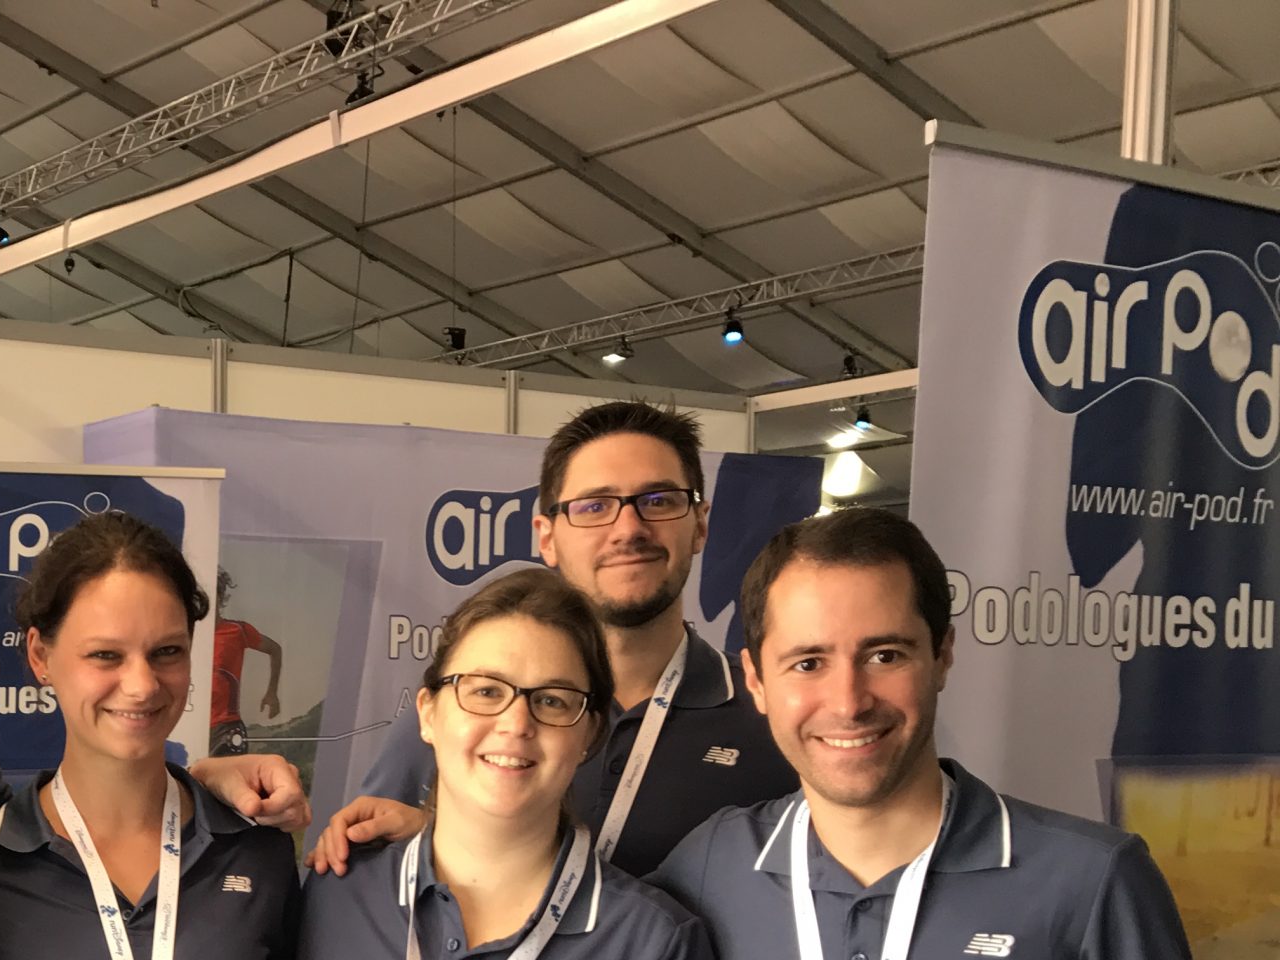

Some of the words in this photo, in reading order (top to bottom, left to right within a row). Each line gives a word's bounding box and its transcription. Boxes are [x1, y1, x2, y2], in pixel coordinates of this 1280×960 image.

[1032, 272, 1149, 390] air
[1161, 268, 1280, 458] pod
[434, 495, 521, 570] air
[1070, 481, 1275, 531] www.air-pod.fr
[1225, 582, 1275, 650] du
